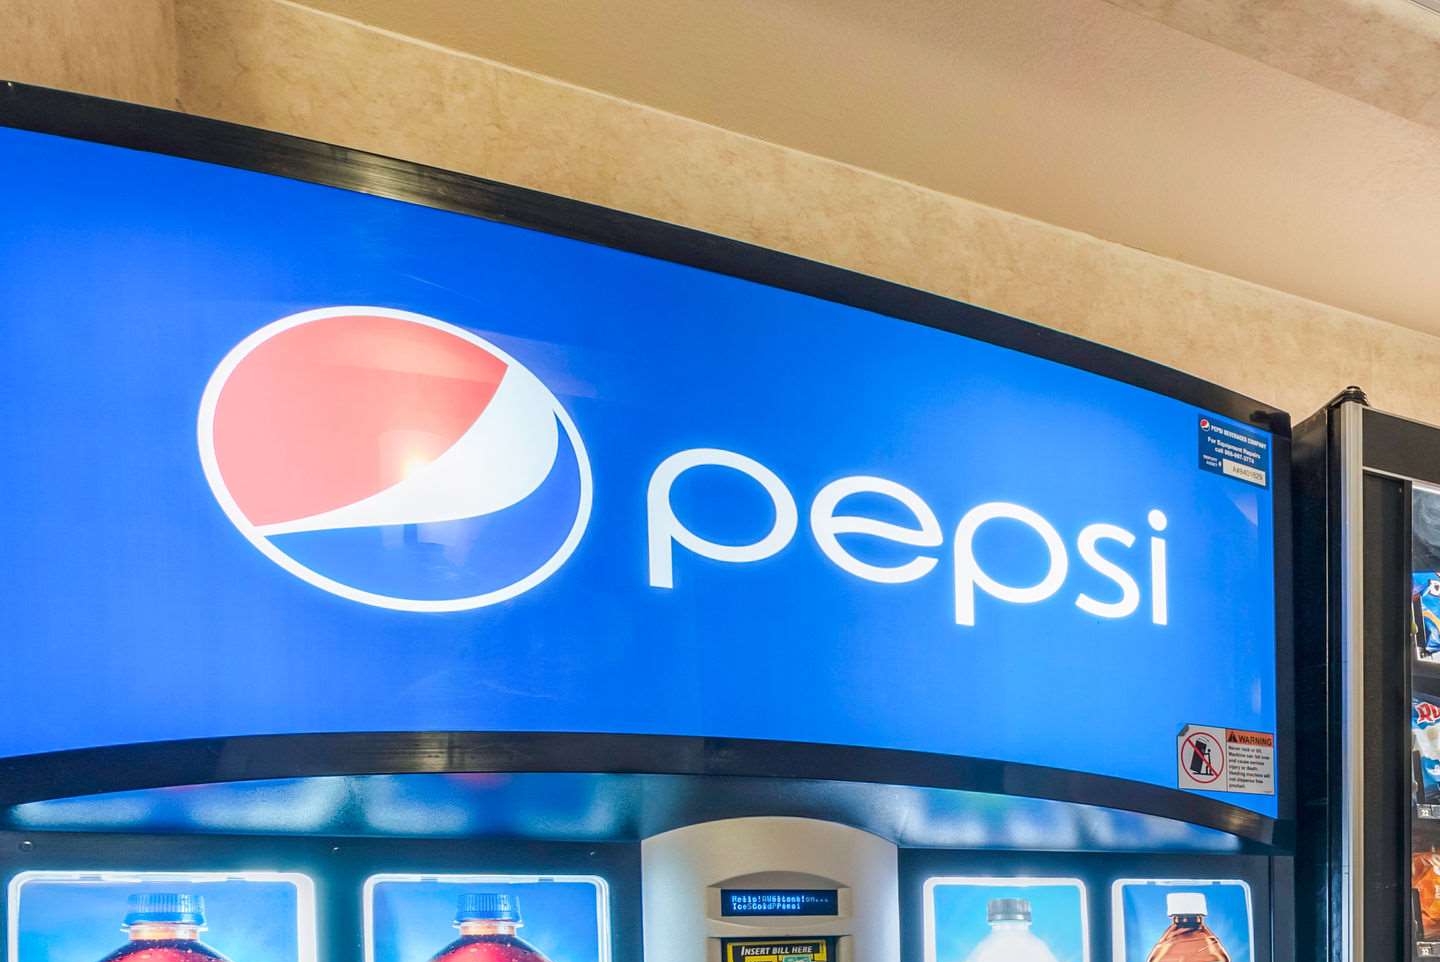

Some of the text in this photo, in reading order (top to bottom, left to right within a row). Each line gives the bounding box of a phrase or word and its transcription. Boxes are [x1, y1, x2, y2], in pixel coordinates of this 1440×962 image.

[647, 447, 1168, 625] pepsi
[741, 945, 813, 956] INSERT BILL HERE
